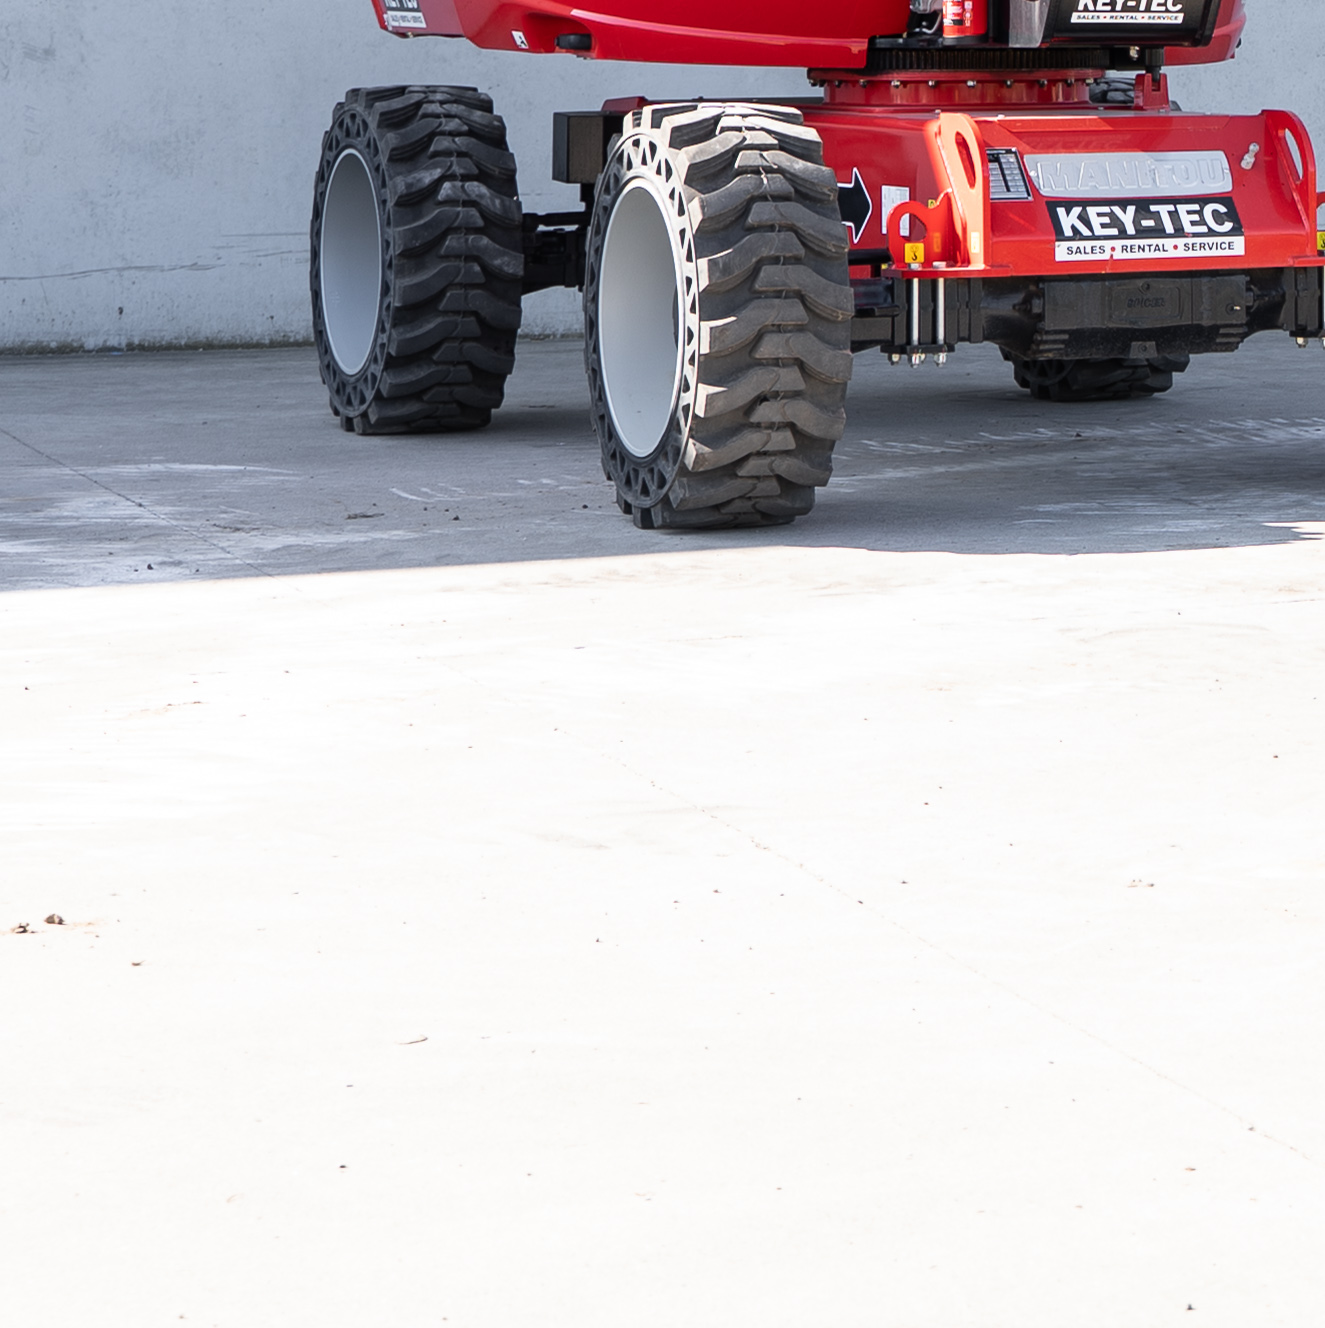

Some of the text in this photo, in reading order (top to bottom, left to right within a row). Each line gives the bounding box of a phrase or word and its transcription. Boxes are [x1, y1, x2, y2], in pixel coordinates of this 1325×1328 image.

[1036, 158, 1226, 191] MANITOU
[1056, 203, 1234, 237] KEY-TEC
[1066, 241, 1235, 256] SALES RENTAL SERVICE
